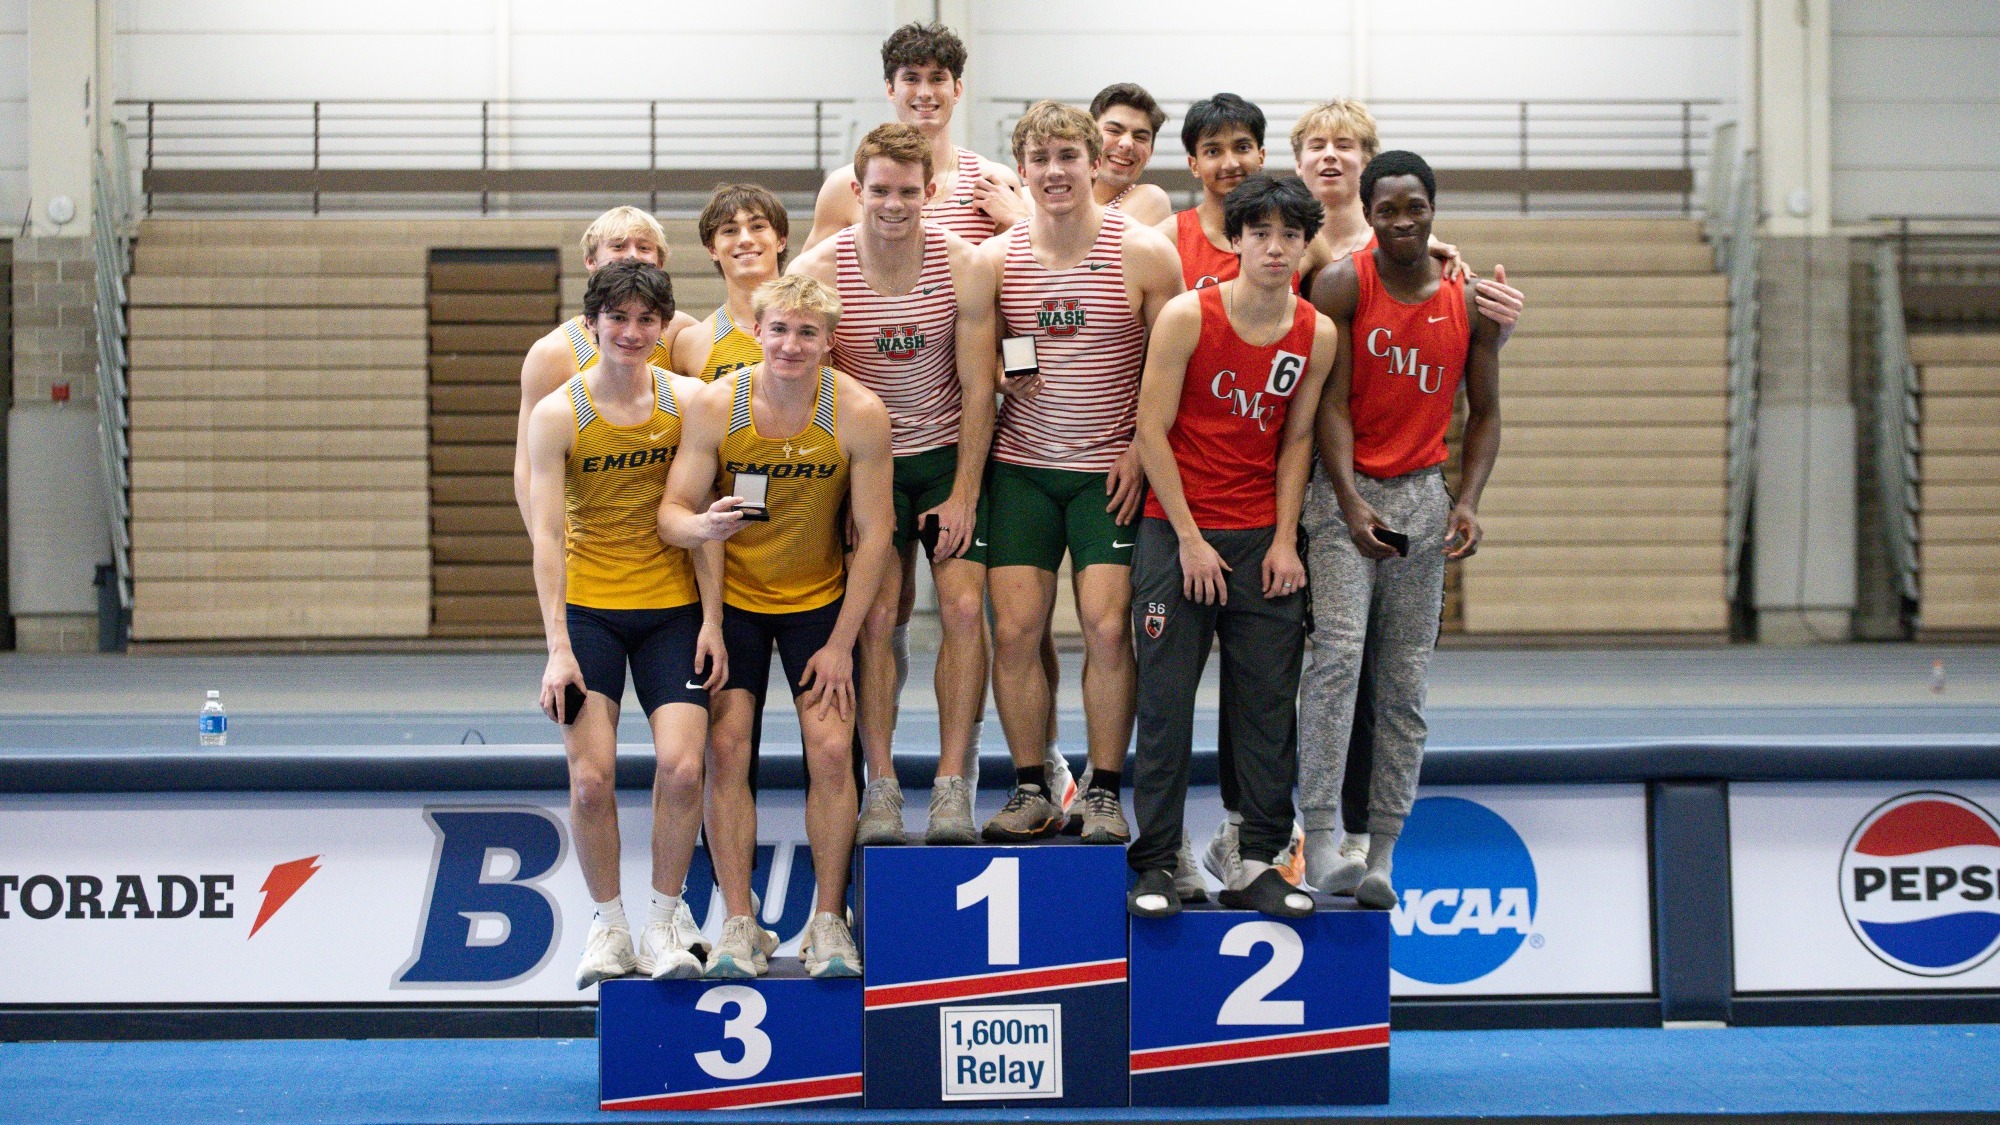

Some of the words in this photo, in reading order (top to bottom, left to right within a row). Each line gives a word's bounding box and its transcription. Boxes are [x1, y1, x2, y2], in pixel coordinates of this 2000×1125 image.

[1036, 310, 1086, 327] WASH
[874, 335, 926, 353] WASH
[1366, 327, 1446, 394] CMU
[1273, 356, 1301, 393] 6
[1210, 369, 1276, 432] CMU
[726, 461, 838, 479] EMORY
[1148, 602, 1166, 615] 56
[956, 857, 1020, 965] 1
[1390, 888, 1532, 936] NCAA
[1216, 921, 1305, 1026] 2
[693, 984, 772, 1080] 3
[951, 1019, 1048, 1051] 1,600m
[957, 1054, 1045, 1090] Relay
